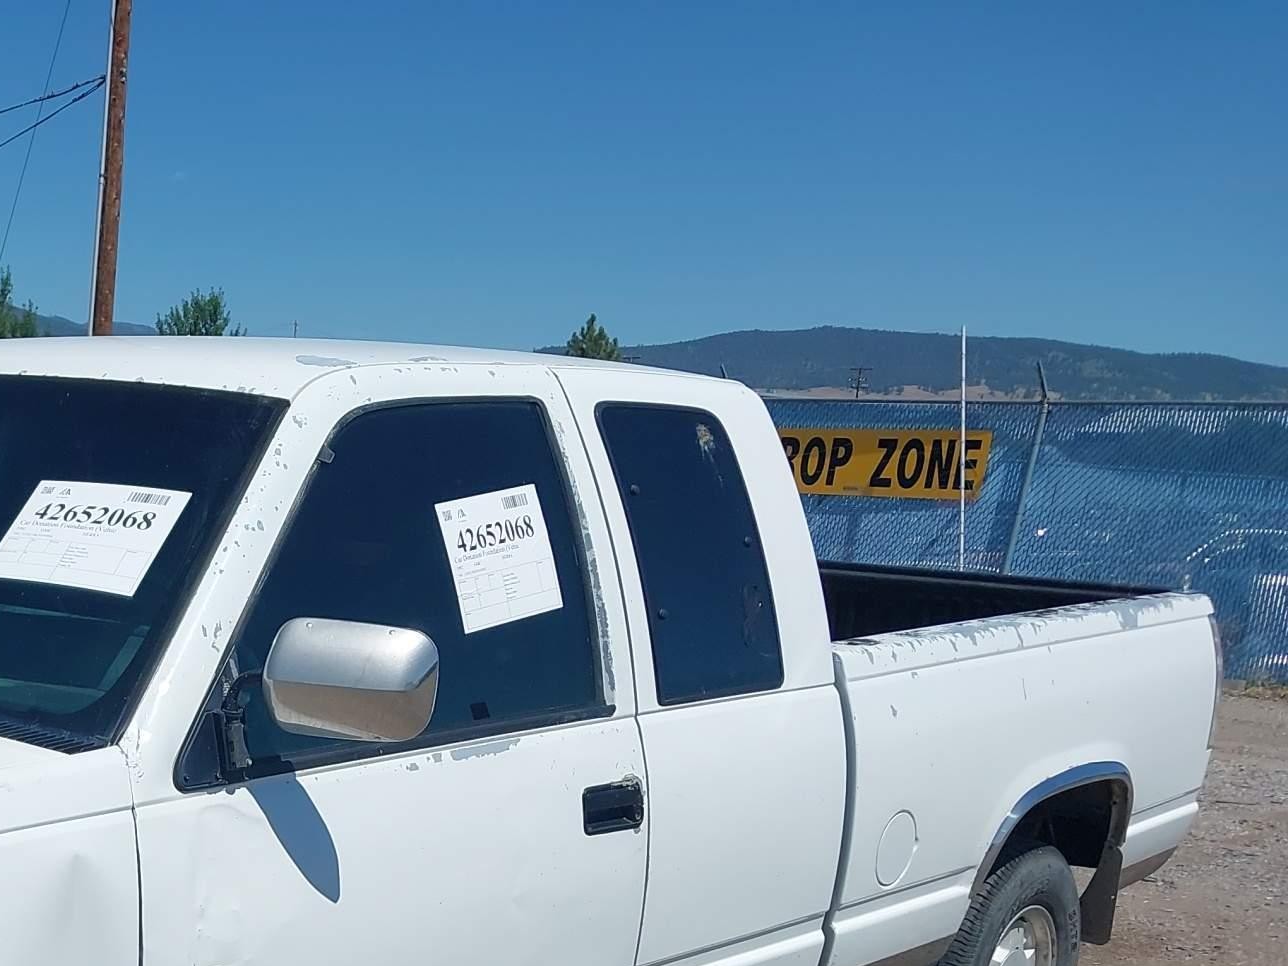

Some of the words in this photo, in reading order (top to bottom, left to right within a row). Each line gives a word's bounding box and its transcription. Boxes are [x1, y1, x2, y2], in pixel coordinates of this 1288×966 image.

[869, 437, 983, 491] ZONE
[34, 502, 157, 531] 42652068
[457, 514, 534, 553] 42652068
